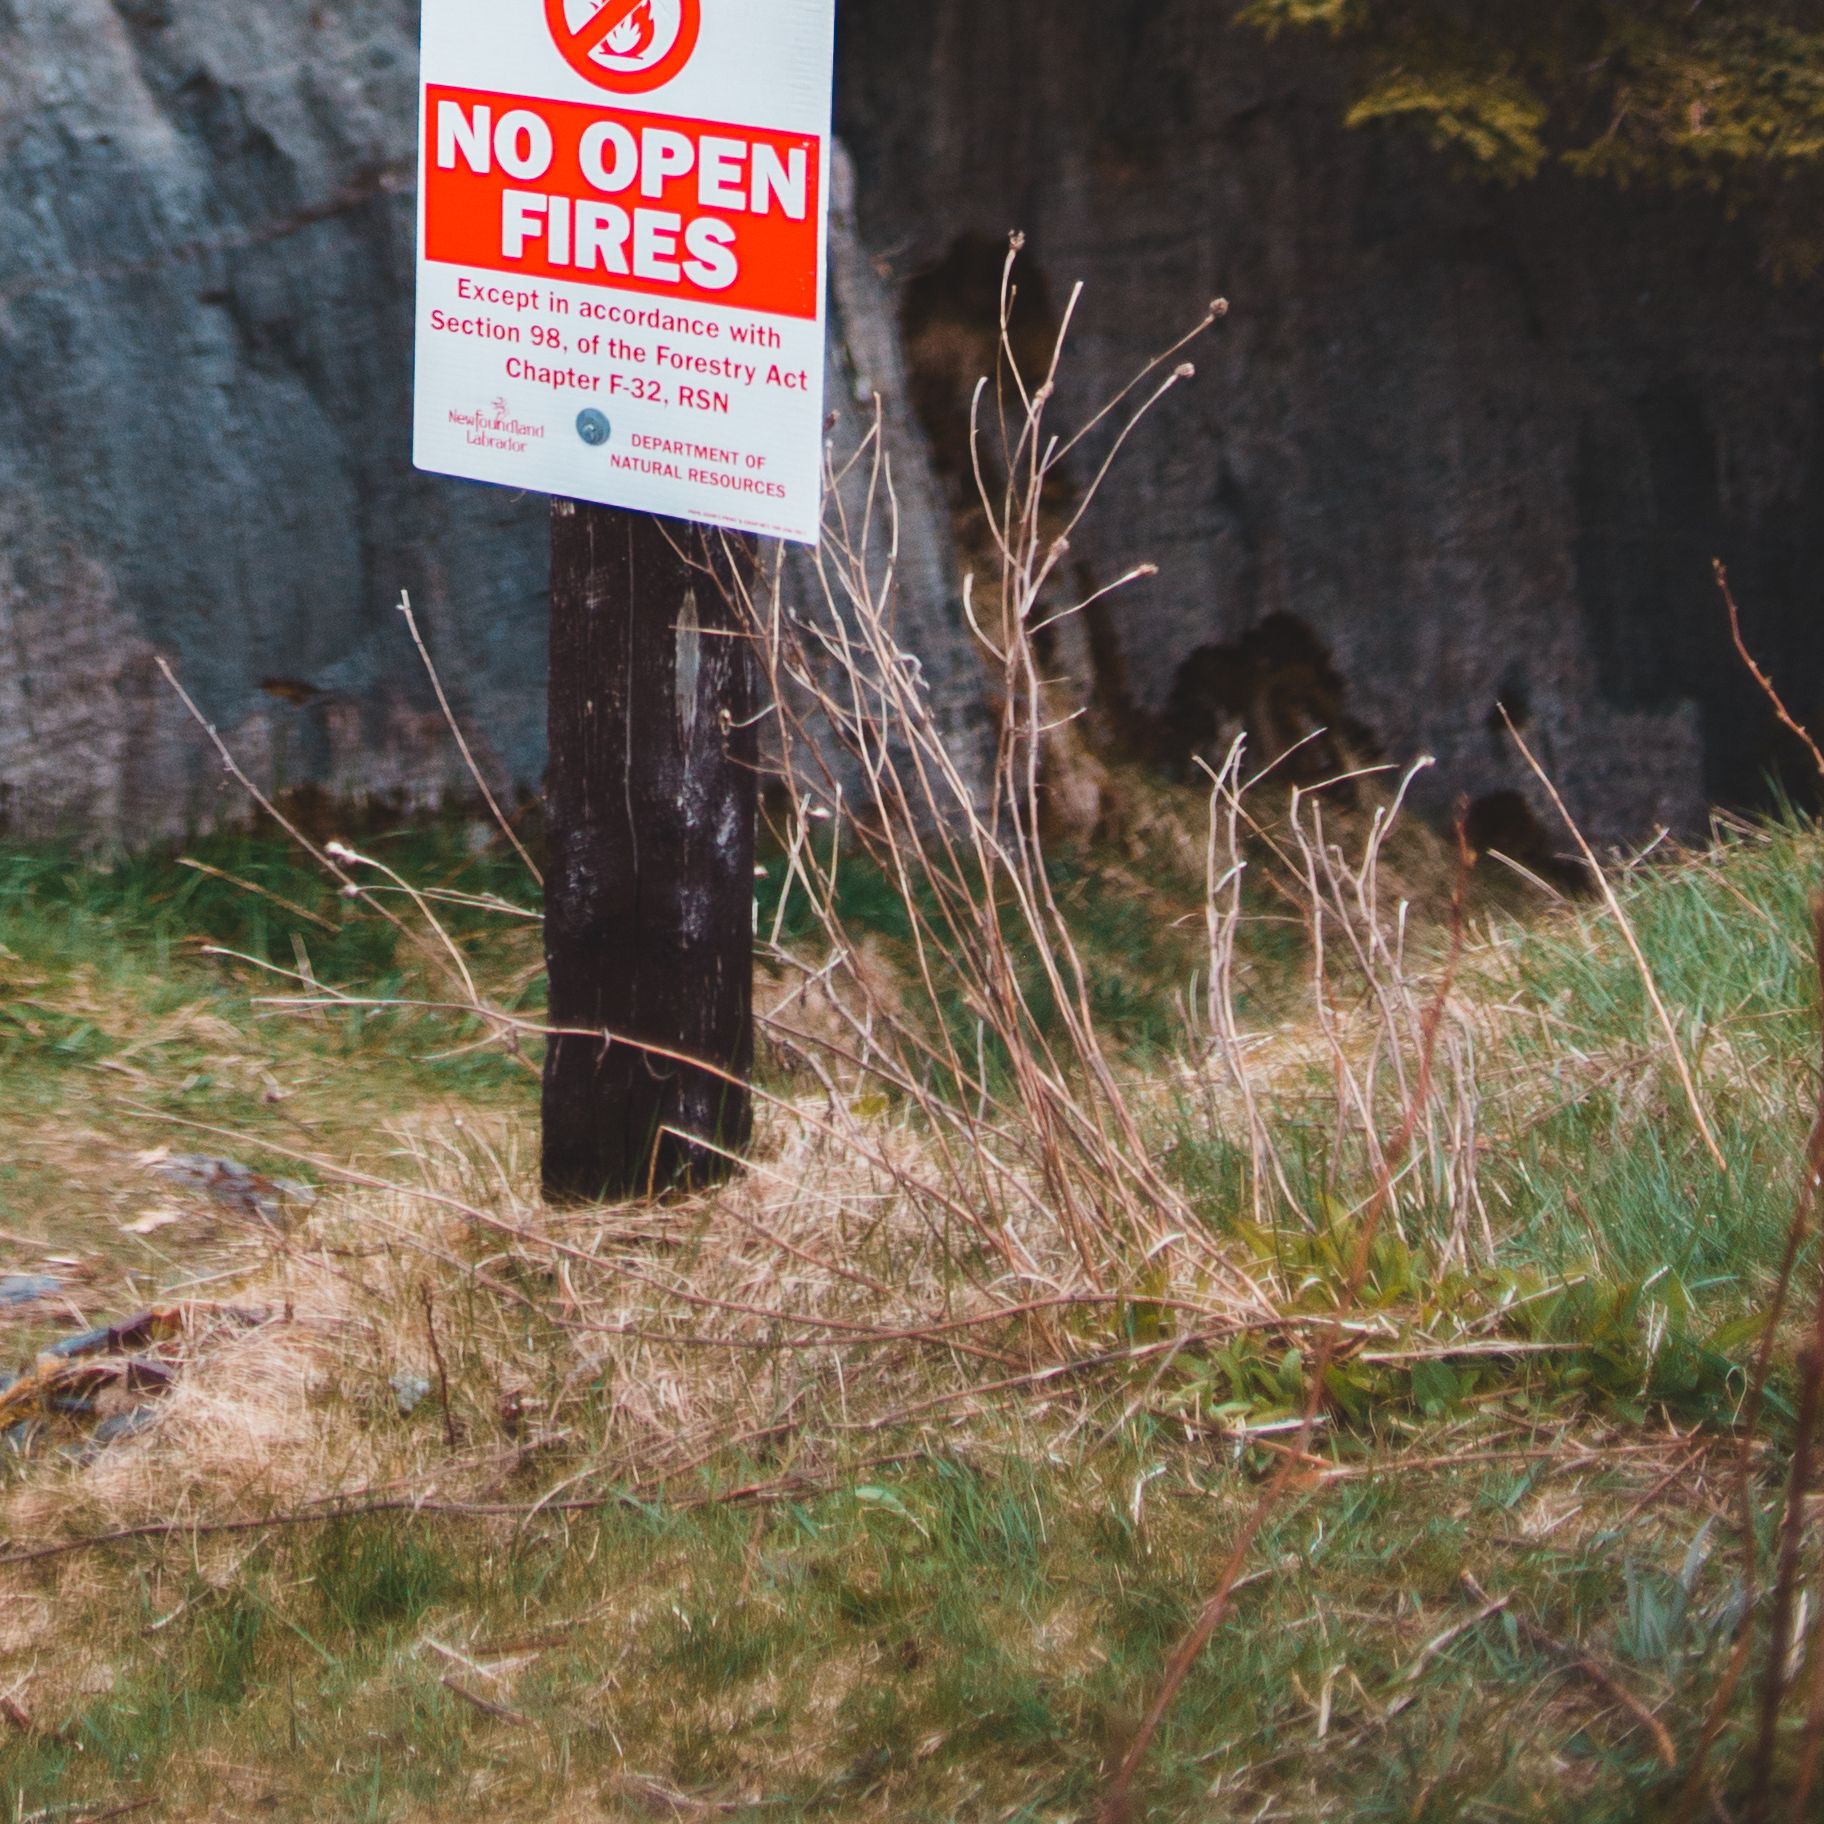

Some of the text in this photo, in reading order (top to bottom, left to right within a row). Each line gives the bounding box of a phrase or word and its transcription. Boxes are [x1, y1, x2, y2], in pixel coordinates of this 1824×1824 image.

[437, 99, 806, 220] NO OPEN
[501, 189, 738, 289] FIRES
[457, 277, 781, 349] Except in accordance with
[430, 309, 807, 390] Section 98, of the Forestry Act
[505, 357, 728, 413] Chapter F-32, RSN
[448, 408, 545, 438] Newfoundland
[466, 429, 528, 452] Labrador
[631, 433, 766, 469] DEPARTMENT OF
[609, 452, 785, 498] NATURAL RESOURCES
